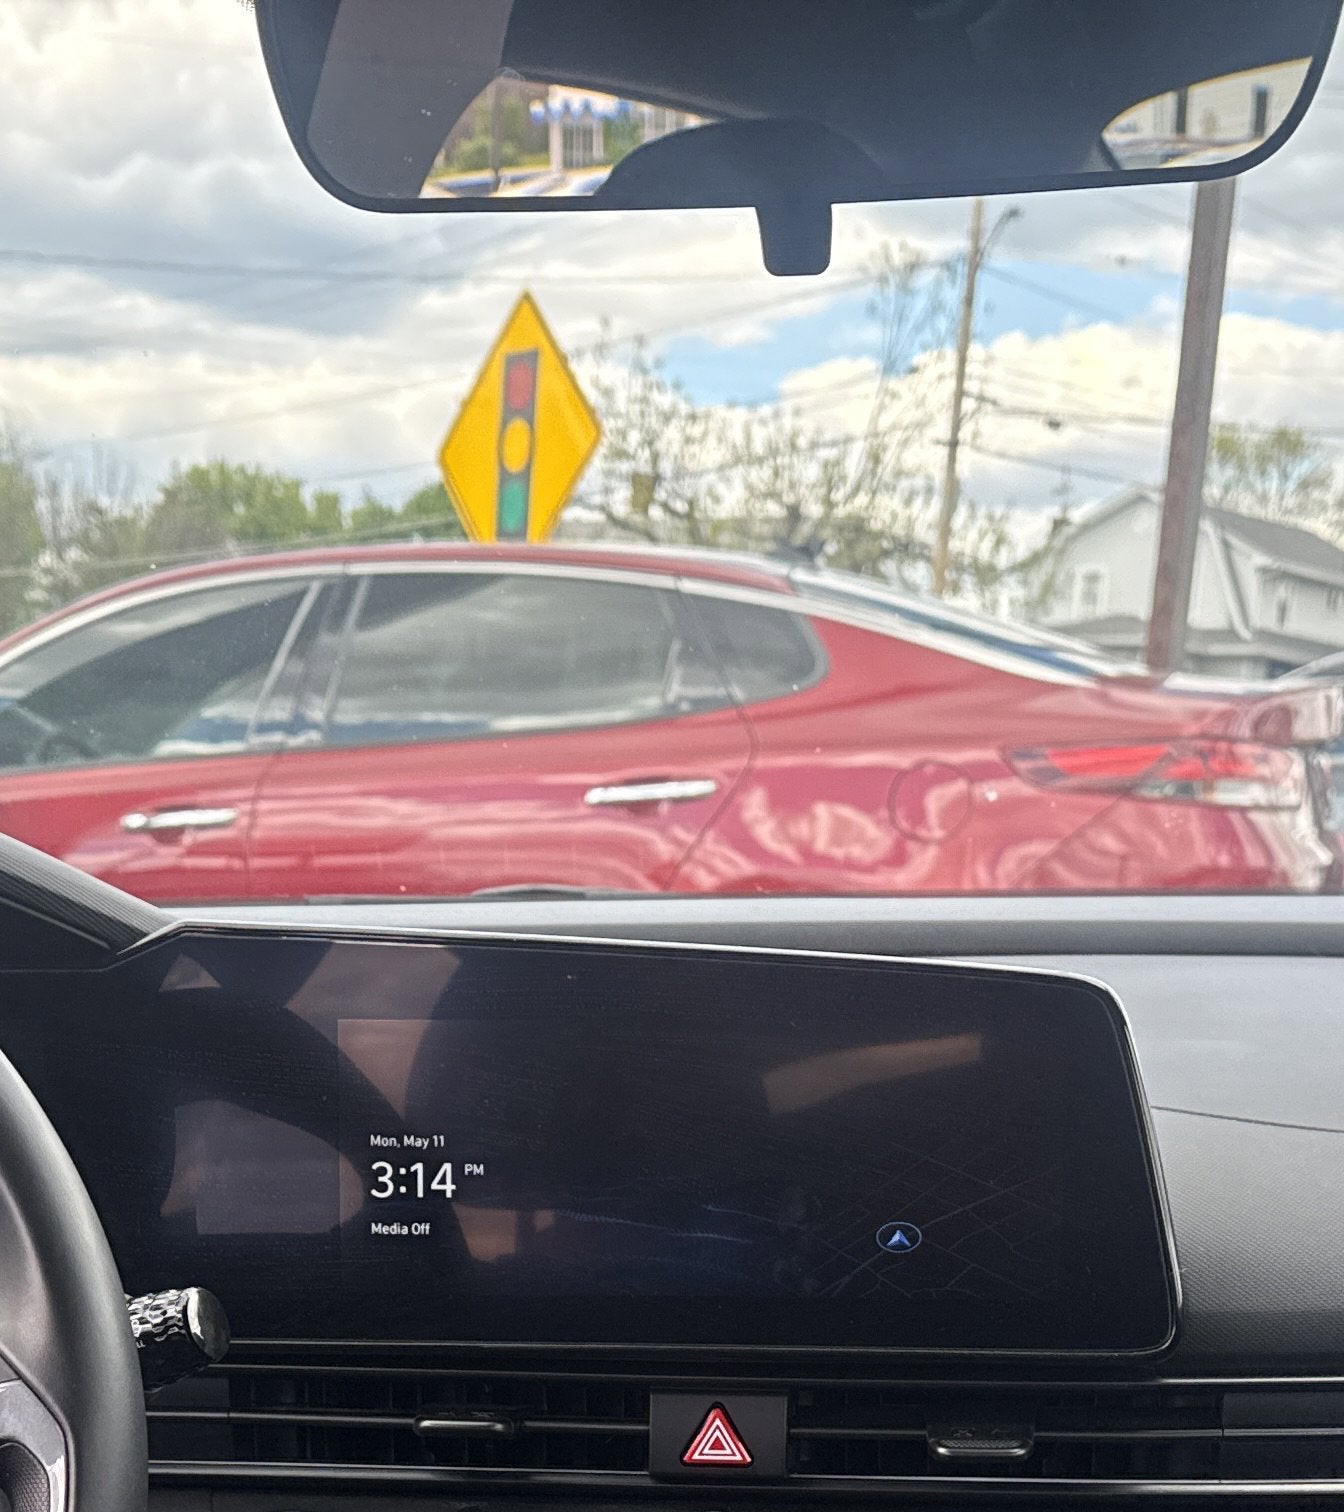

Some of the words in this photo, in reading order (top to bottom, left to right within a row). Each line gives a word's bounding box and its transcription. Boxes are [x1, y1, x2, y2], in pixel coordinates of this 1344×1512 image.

[370, 1134, 400, 1148] Mon,
[403, 1135, 429, 1150] May
[432, 1135, 445, 1147] 11
[370, 1161, 457, 1198] 3:14
[464, 1164, 484, 1175] PM
[371, 1222, 408, 1235] Media
[411, 1222, 431, 1235] Off
